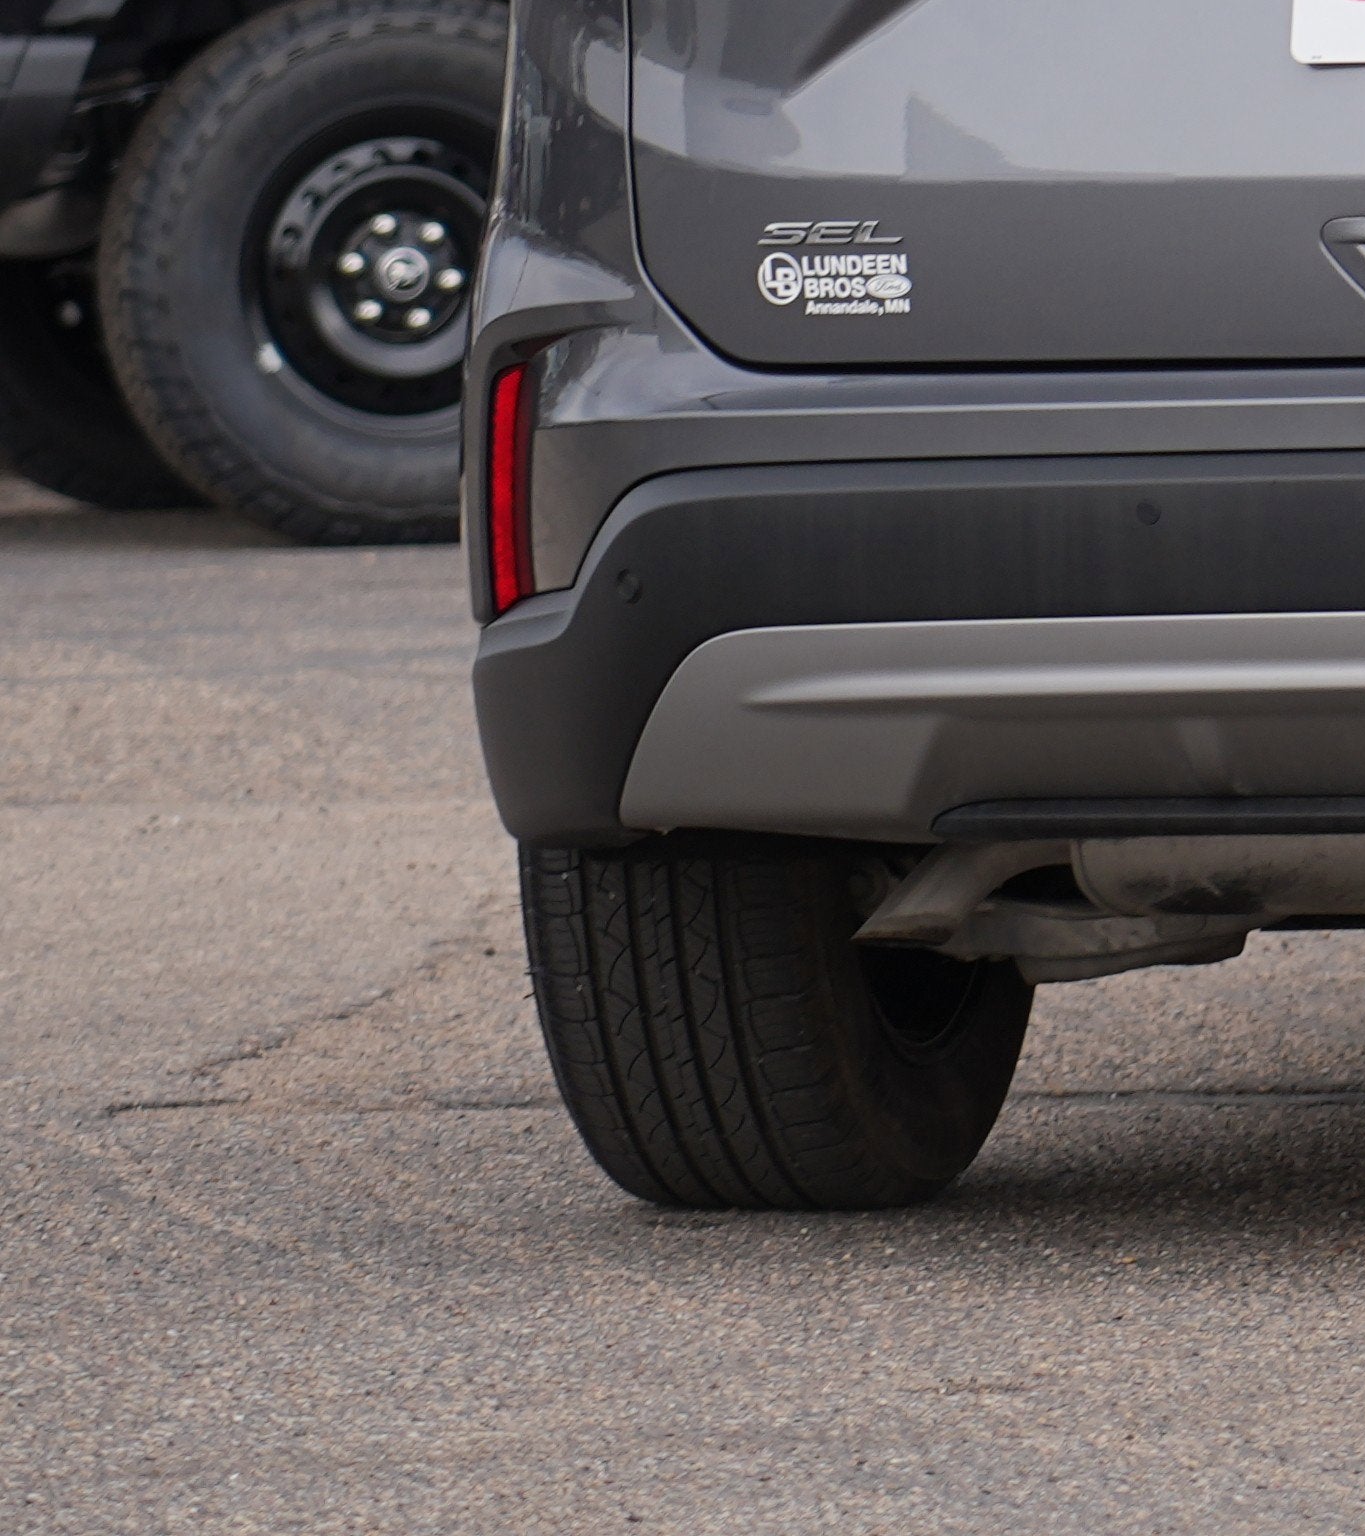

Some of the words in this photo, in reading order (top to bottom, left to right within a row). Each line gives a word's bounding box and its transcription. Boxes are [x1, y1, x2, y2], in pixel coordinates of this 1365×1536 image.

[757, 220, 903, 245] SEL
[801, 254, 908, 276] LUNDEEN
[803, 277, 867, 299] BROS
[805, 299, 883, 316] Annandale,
[884, 299, 911, 314] MN
